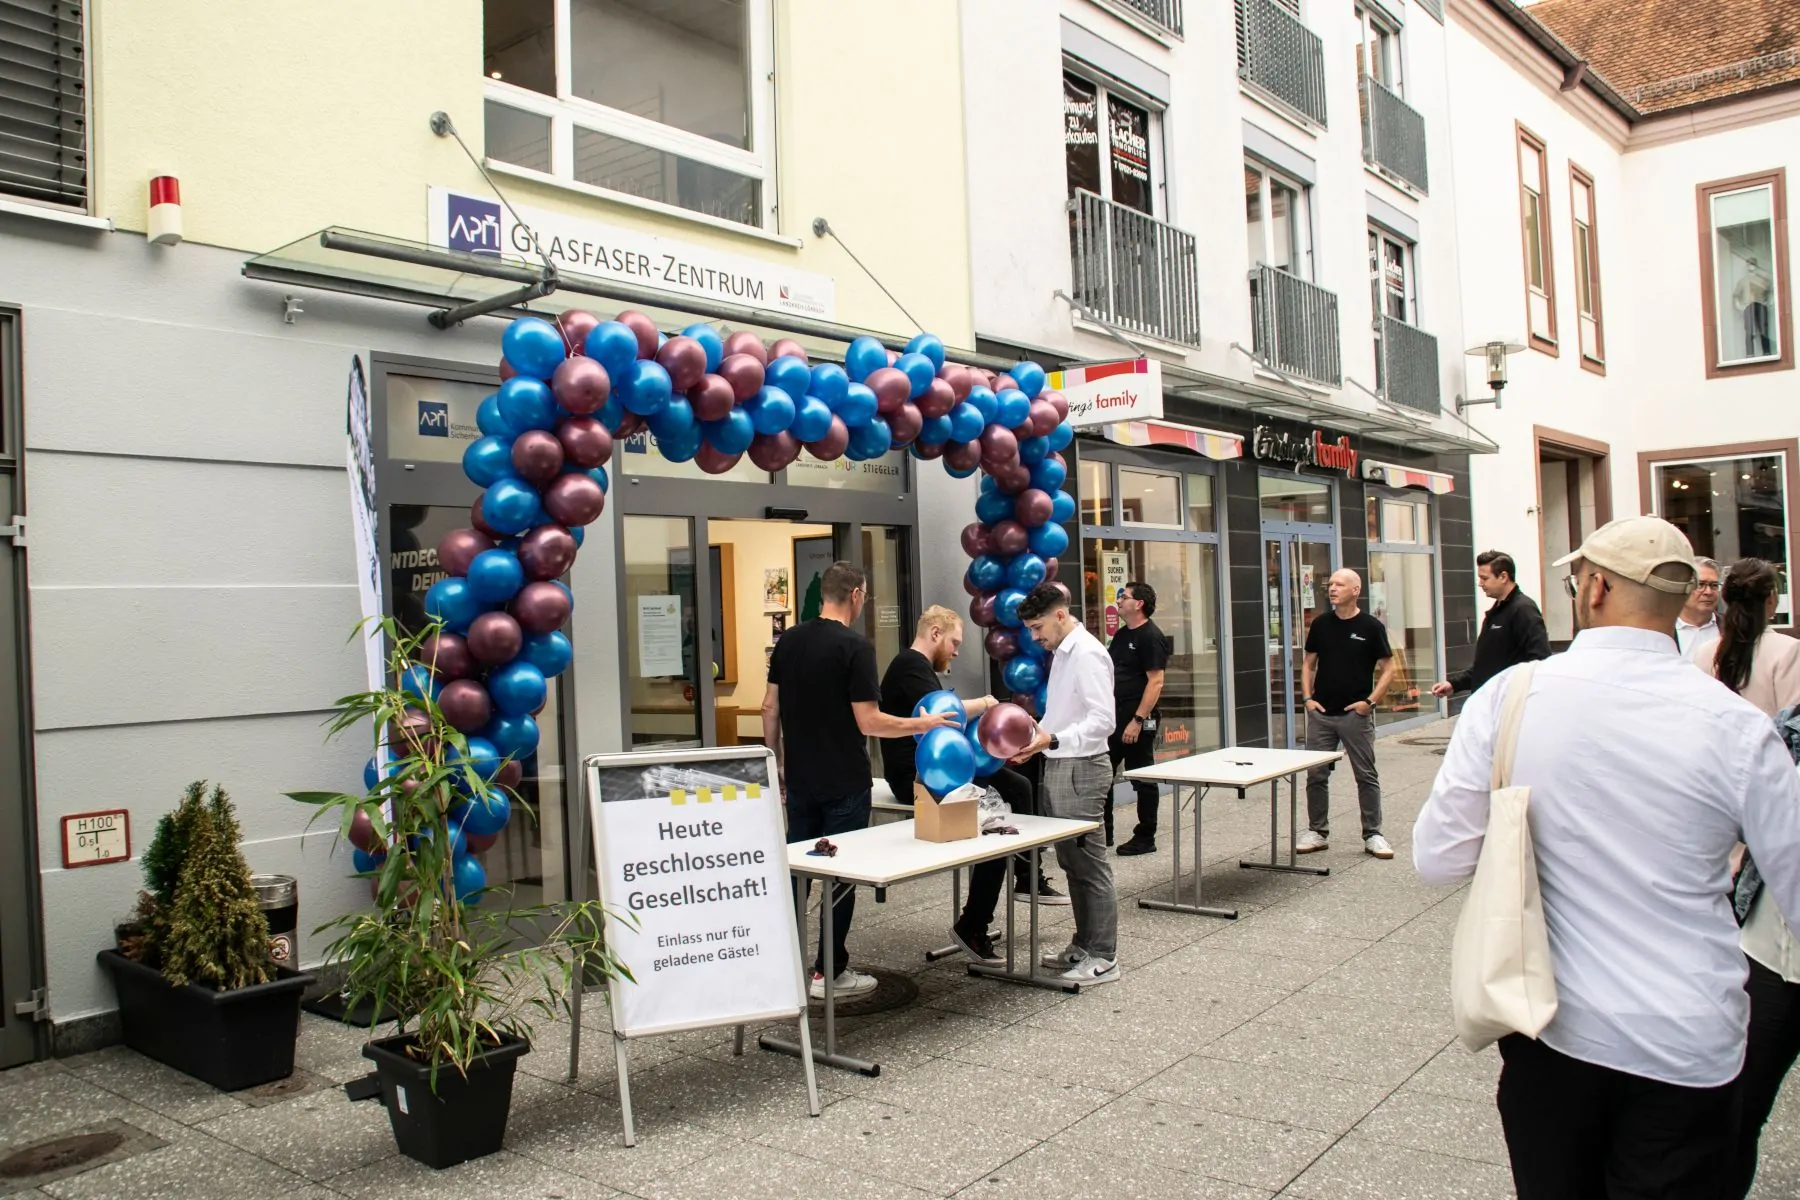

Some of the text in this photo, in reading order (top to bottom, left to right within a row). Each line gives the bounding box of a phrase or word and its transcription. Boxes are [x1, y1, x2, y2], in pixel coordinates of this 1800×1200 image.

[1064, 128, 1098, 144] erkaufen
[511, 222, 765, 301] GLASFASER-ZENTRUM
[1096, 389, 1137, 409] family
[1312, 429, 1358, 480] family
[391, 548, 440, 569] NTDEC
[1107, 566, 1124, 574] SUCHEN
[658, 819, 723, 841] Heute
[623, 849, 765, 882] geschlossene
[628, 877, 768, 911] Gesellschaft!
[657, 925, 751, 948] Einlass nur für
[653, 943, 760, 972] geladene Gäste!
